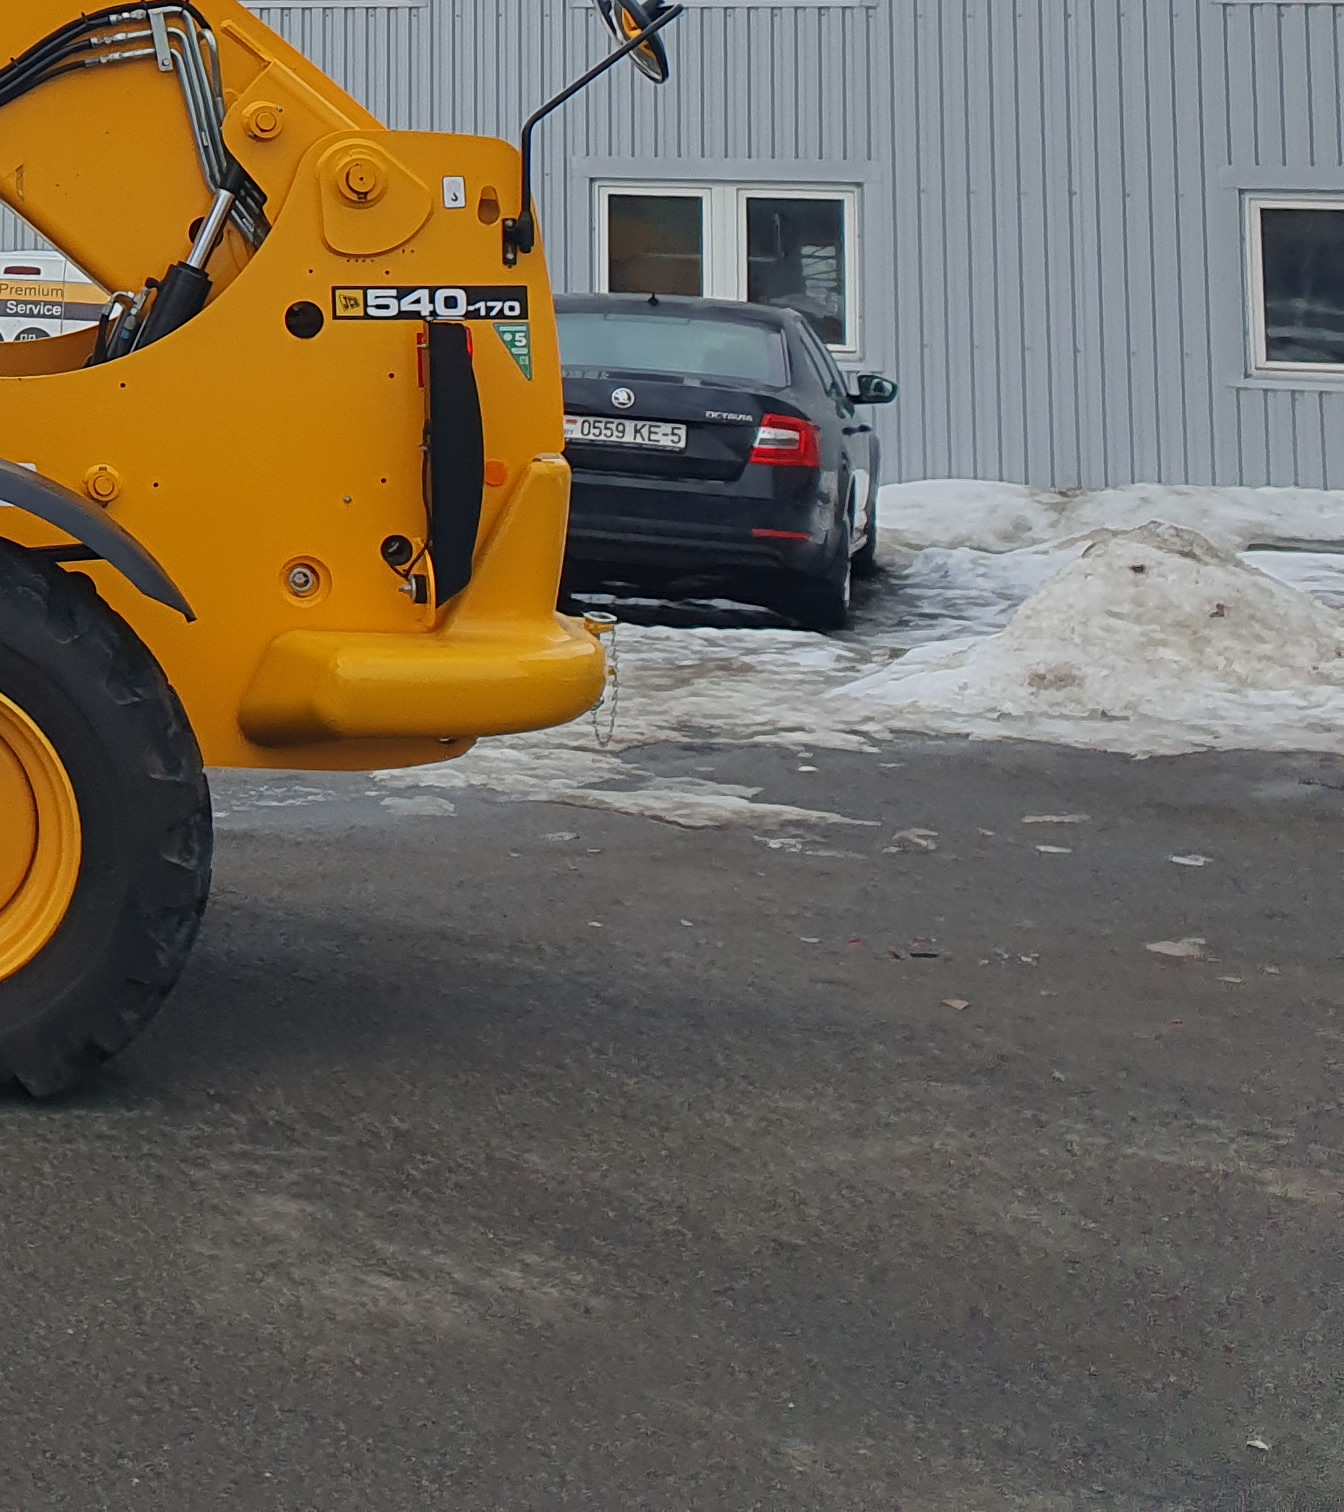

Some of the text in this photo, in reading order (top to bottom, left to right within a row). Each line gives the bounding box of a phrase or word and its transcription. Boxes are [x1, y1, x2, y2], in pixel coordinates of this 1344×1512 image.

[6, 300, 62, 316] Service
[366, 288, 521, 317] 540-170
[514, 332, 527, 347] 5
[581, 419, 682, 445] 0559 KE-5
